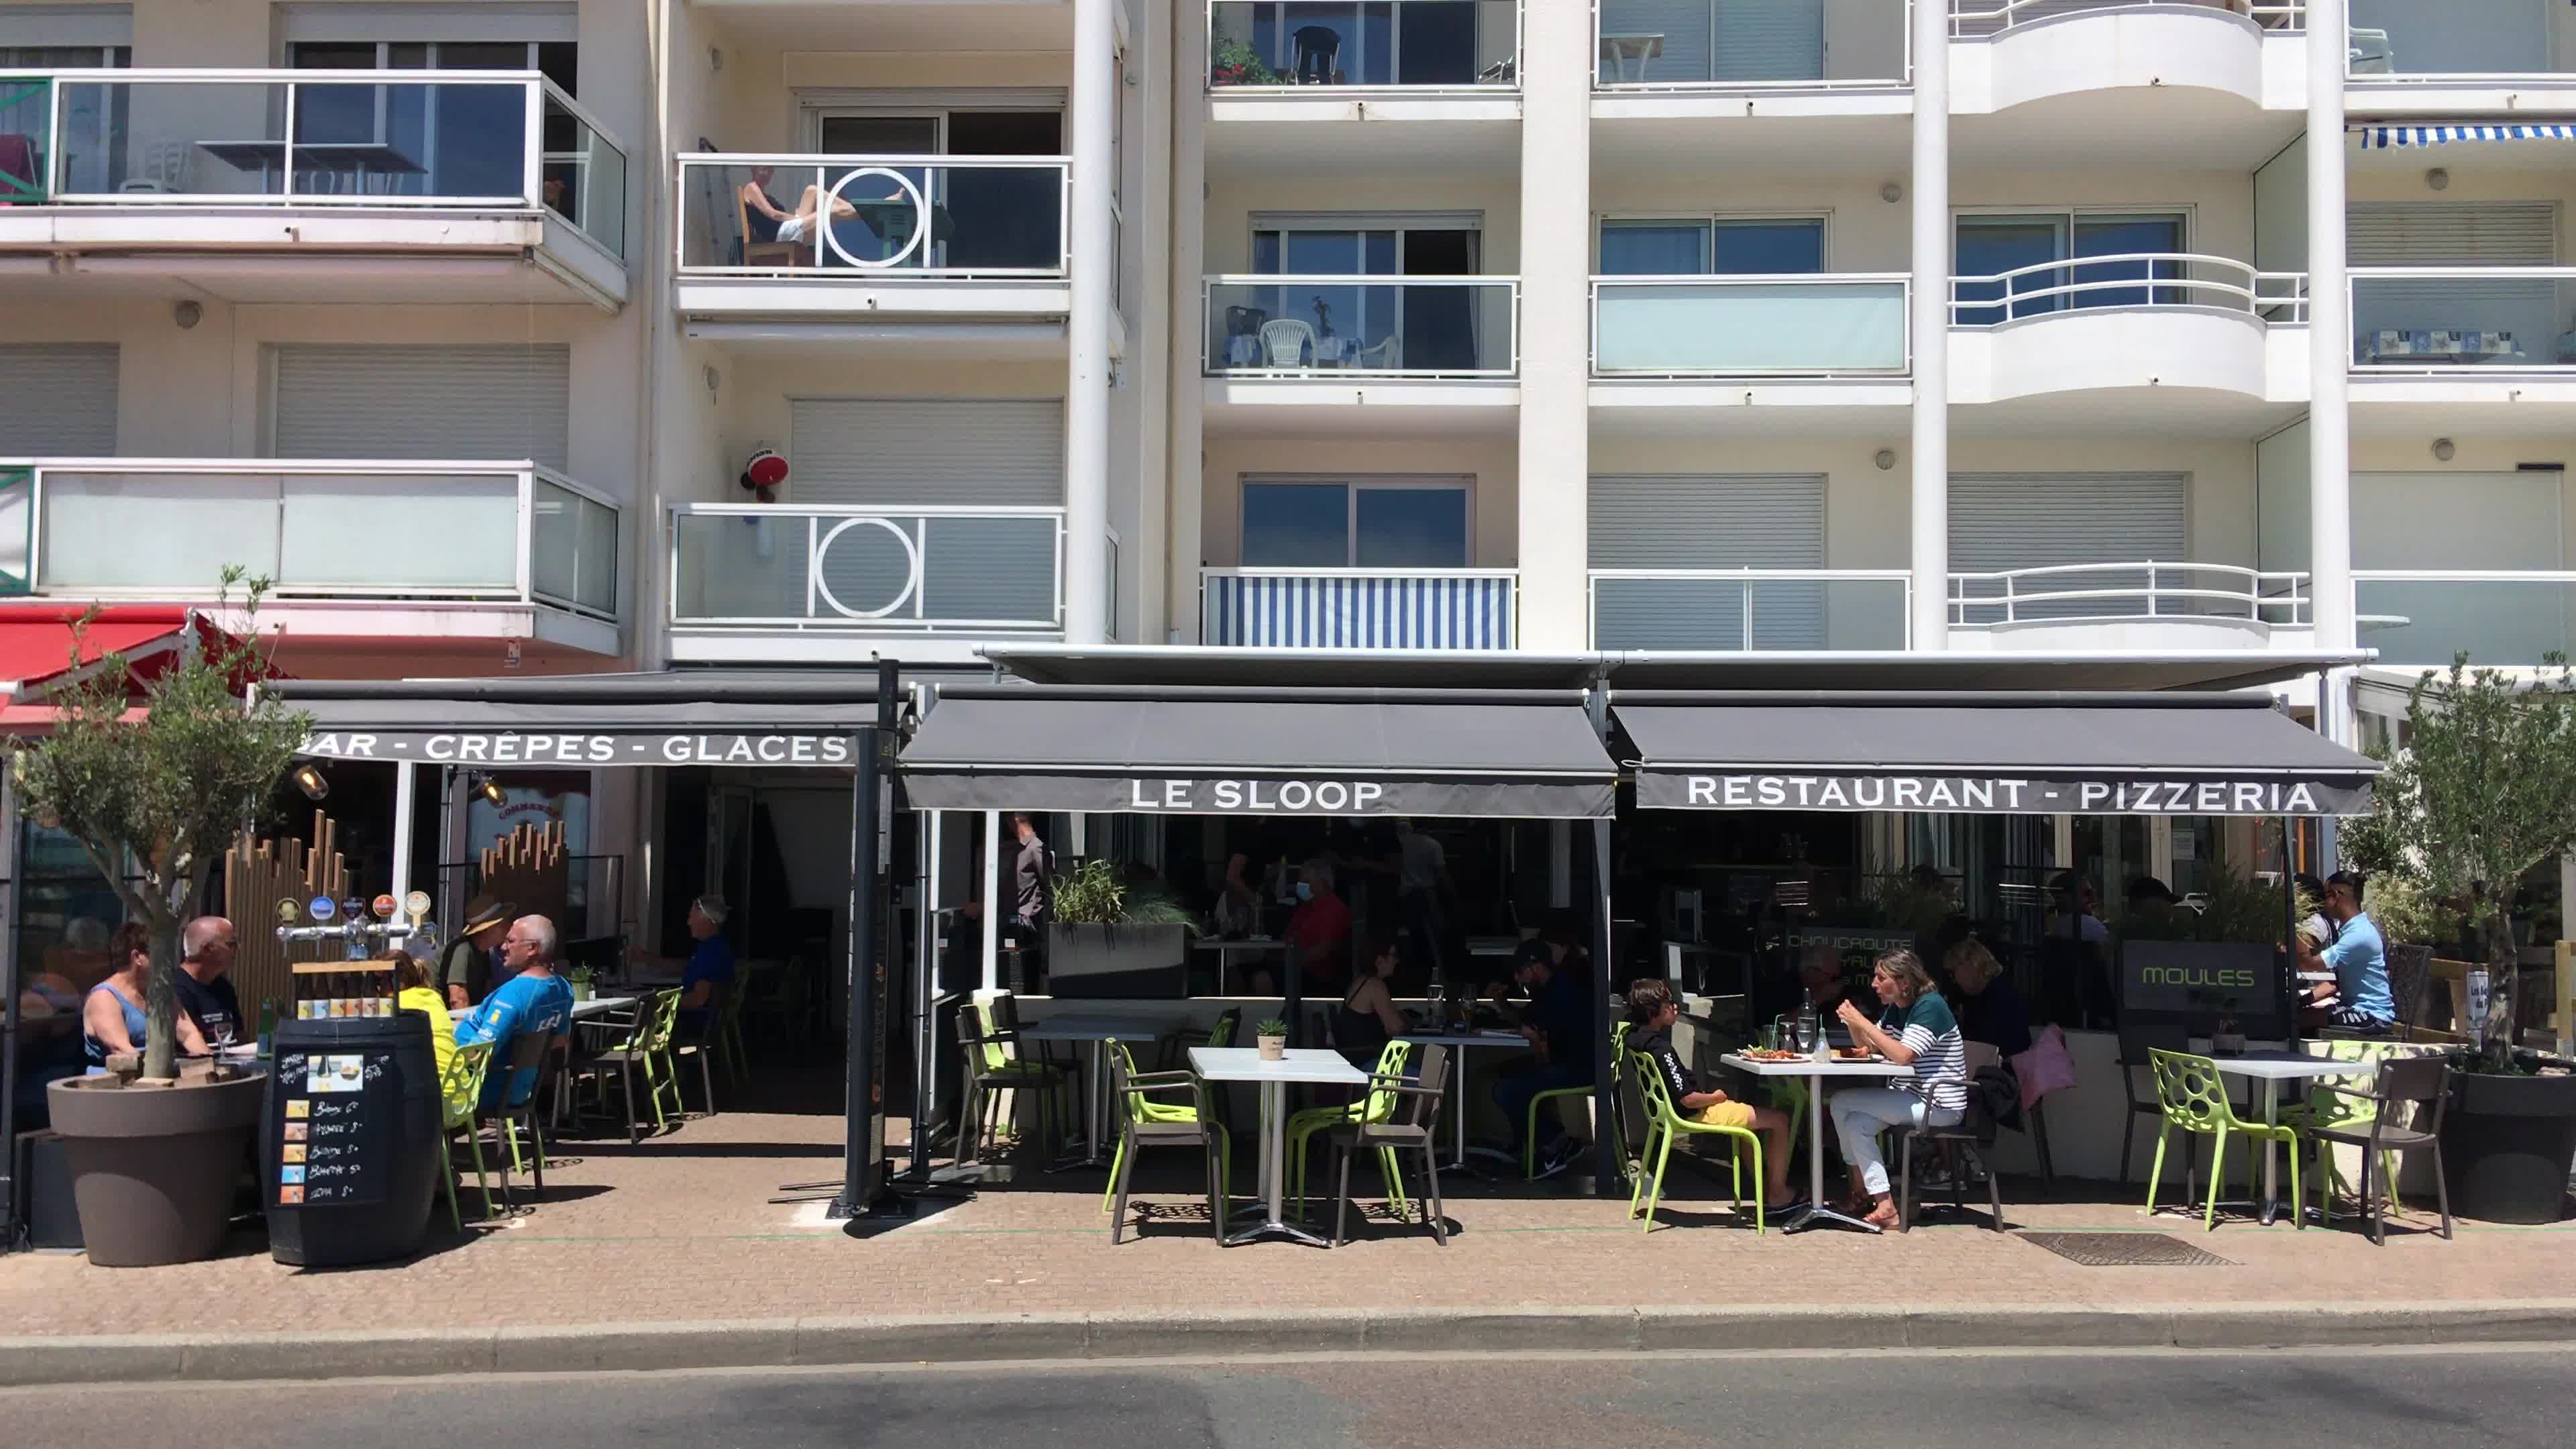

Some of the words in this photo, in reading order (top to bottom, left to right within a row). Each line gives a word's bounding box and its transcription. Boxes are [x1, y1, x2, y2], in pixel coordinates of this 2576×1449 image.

[663, 736, 847, 761] GLACES
[1132, 780, 1192, 808] LE
[1214, 781, 1382, 810] SLOOP
[1687, 776, 2027, 808] RESTAURANT
[2081, 782, 2317, 810] PIZZERIA
[2142, 966, 2255, 987] MOULES
